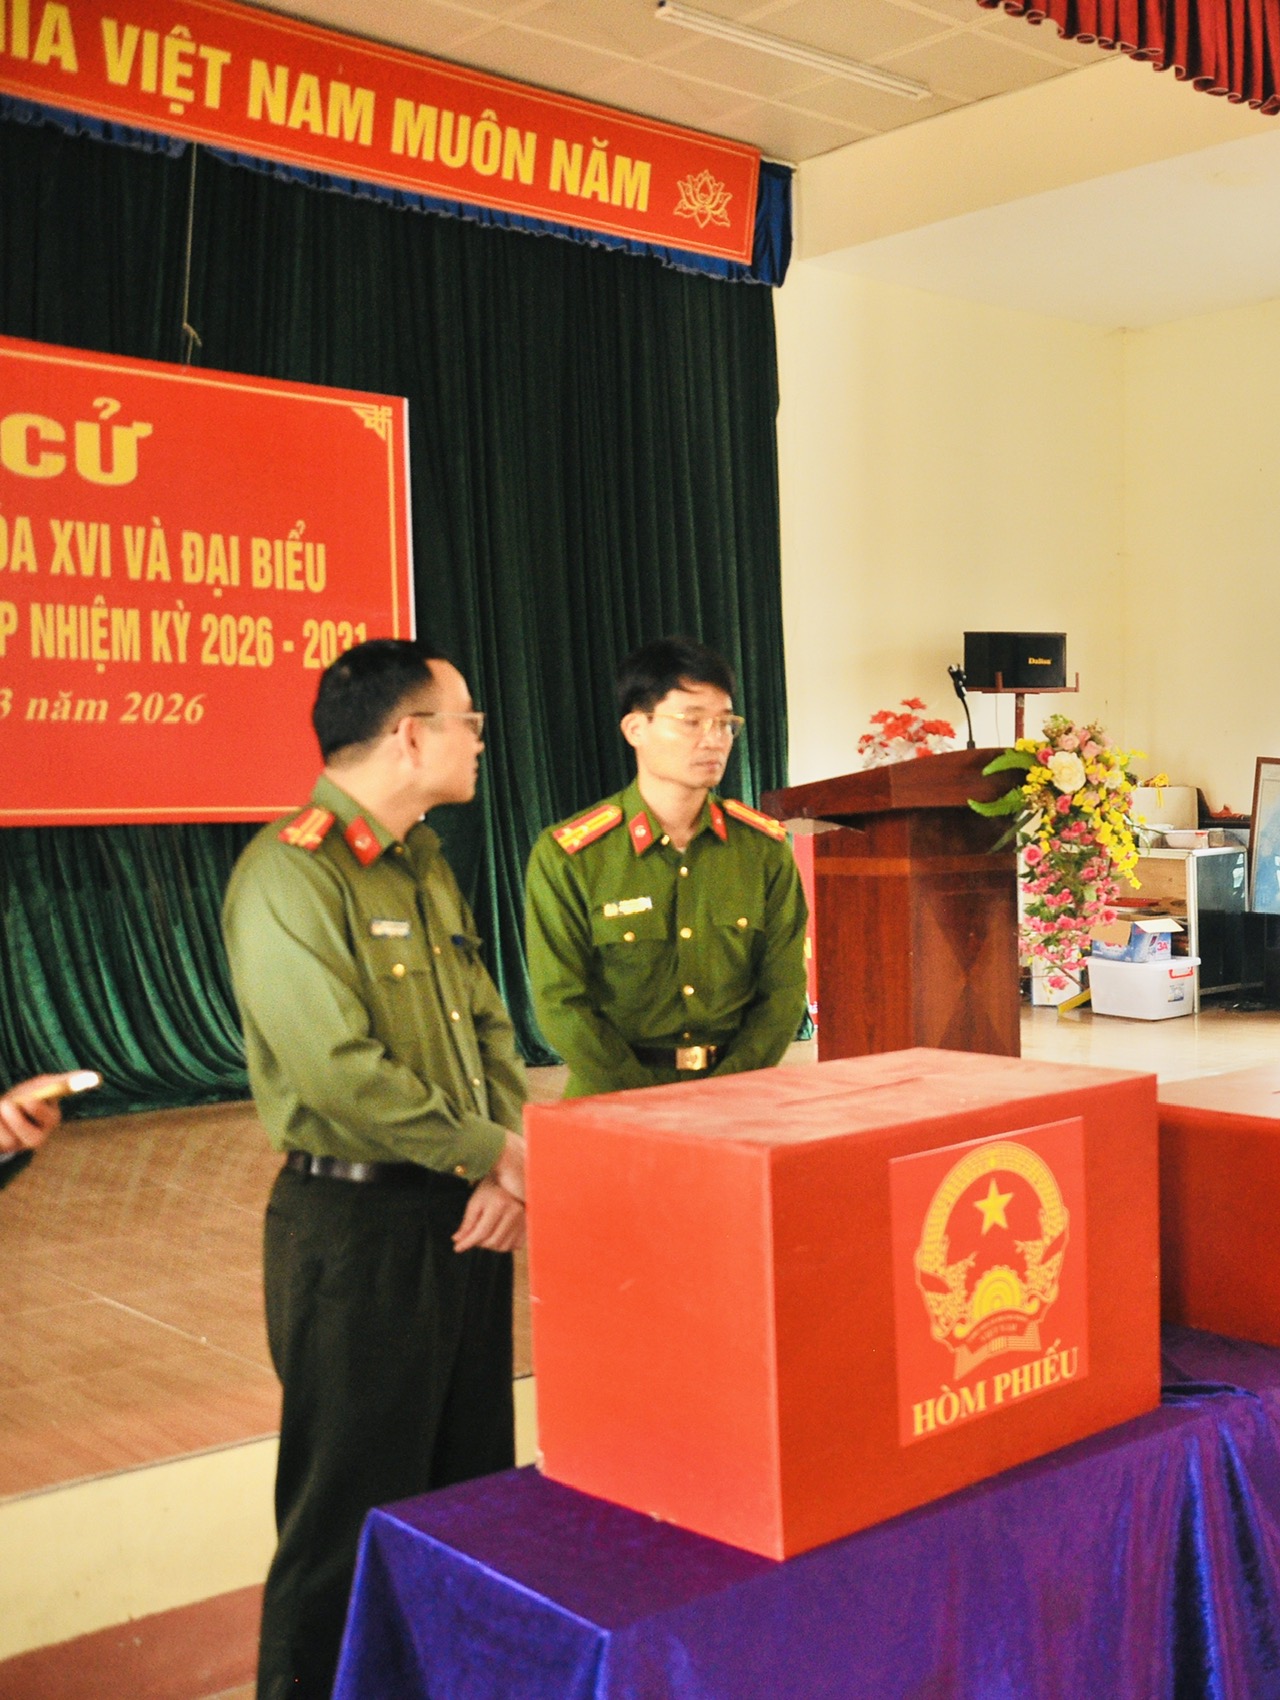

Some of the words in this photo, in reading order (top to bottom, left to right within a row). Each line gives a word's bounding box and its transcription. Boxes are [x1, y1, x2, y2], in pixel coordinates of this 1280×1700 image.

[0, 0, 78, 73] IA
[102, 17, 232, 115] VIỆT
[247, 59, 376, 146] NAM
[391, 98, 537, 185] MUÔN
[549, 136, 651, 212] NĂM
[0, 397, 153, 487] CỬ
[50, 518, 111, 578] XVI
[122, 516, 172, 582] VÀ
[181, 530, 241, 598] ĐẠI
[251, 519, 327, 593] BIỂU
[30, 594, 141, 674] NHIỆM
[150, 599, 191, 664] KỲ
[201, 612, 275, 668] 2026
[26, 690, 109, 721] năm
[120, 691, 207, 724] 2026
[912, 1384, 987, 1437] HÒM
[993, 1338, 1079, 1405] PHIẾU
